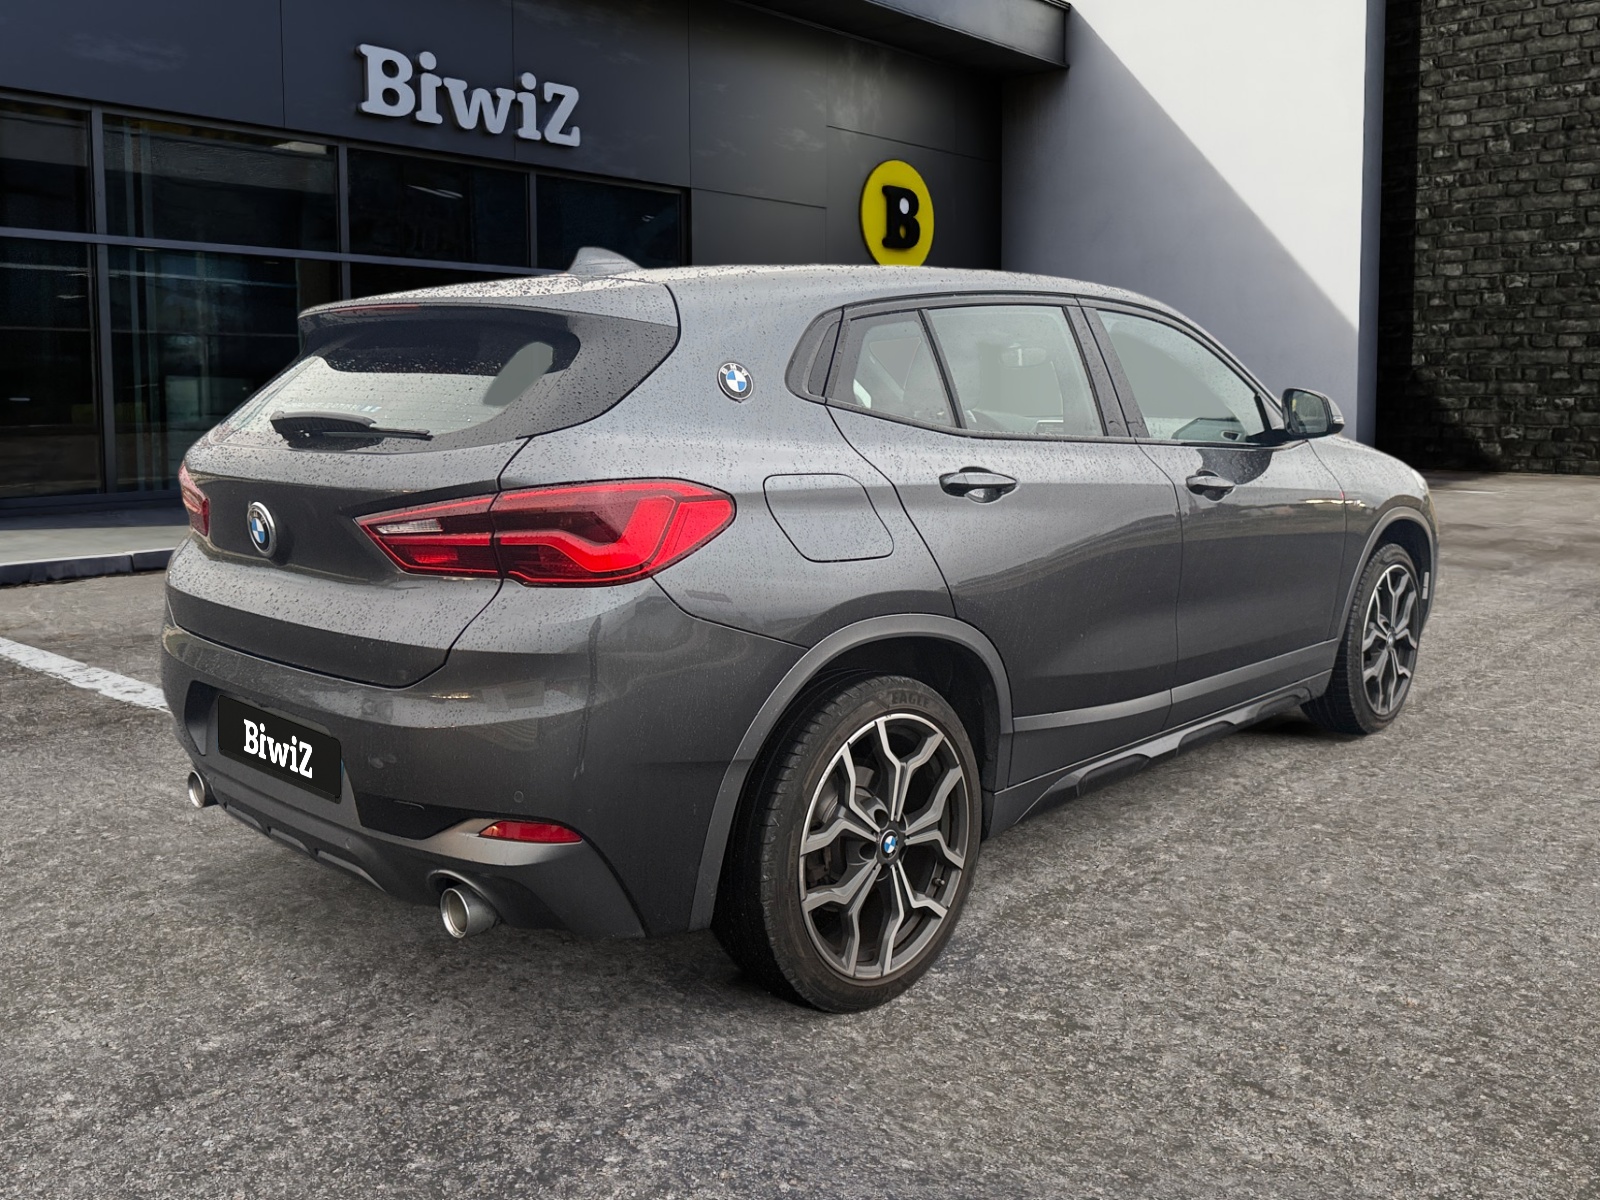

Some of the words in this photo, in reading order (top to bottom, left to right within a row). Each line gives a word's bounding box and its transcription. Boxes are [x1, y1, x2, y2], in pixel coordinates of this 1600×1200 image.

[357, 43, 580, 147] BiwiZ
[882, 185, 920, 249] B
[720, 363, 749, 377] BMW
[891, 690, 930, 709] EAGLE
[243, 718, 313, 779] BiwiZ
